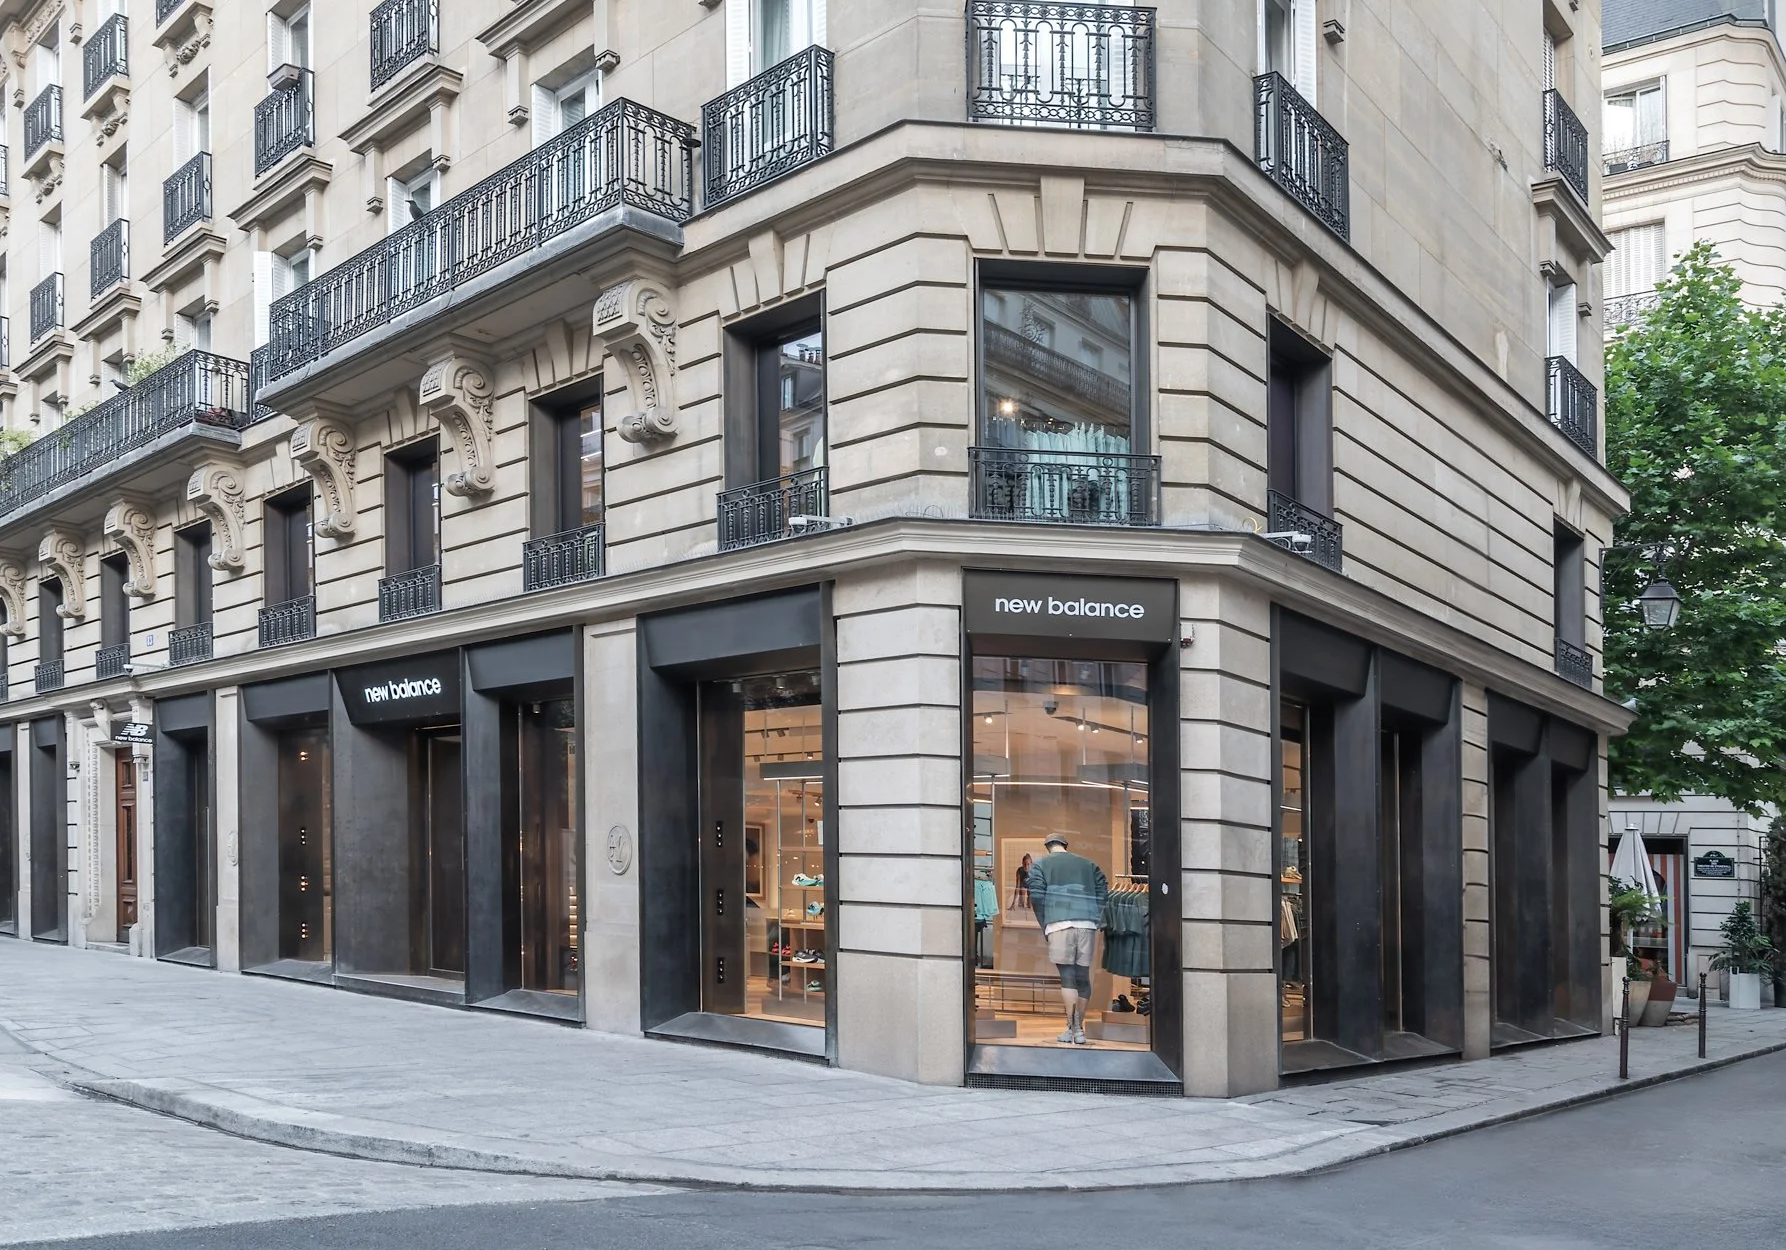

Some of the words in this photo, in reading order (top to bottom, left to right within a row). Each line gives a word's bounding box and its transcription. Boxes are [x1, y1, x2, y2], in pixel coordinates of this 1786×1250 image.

[995, 597, 1043, 614] new
[1048, 596, 1145, 619] balance
[364, 685, 389, 703] new
[388, 677, 442, 700] balance
[120, 723, 149, 737] NB
